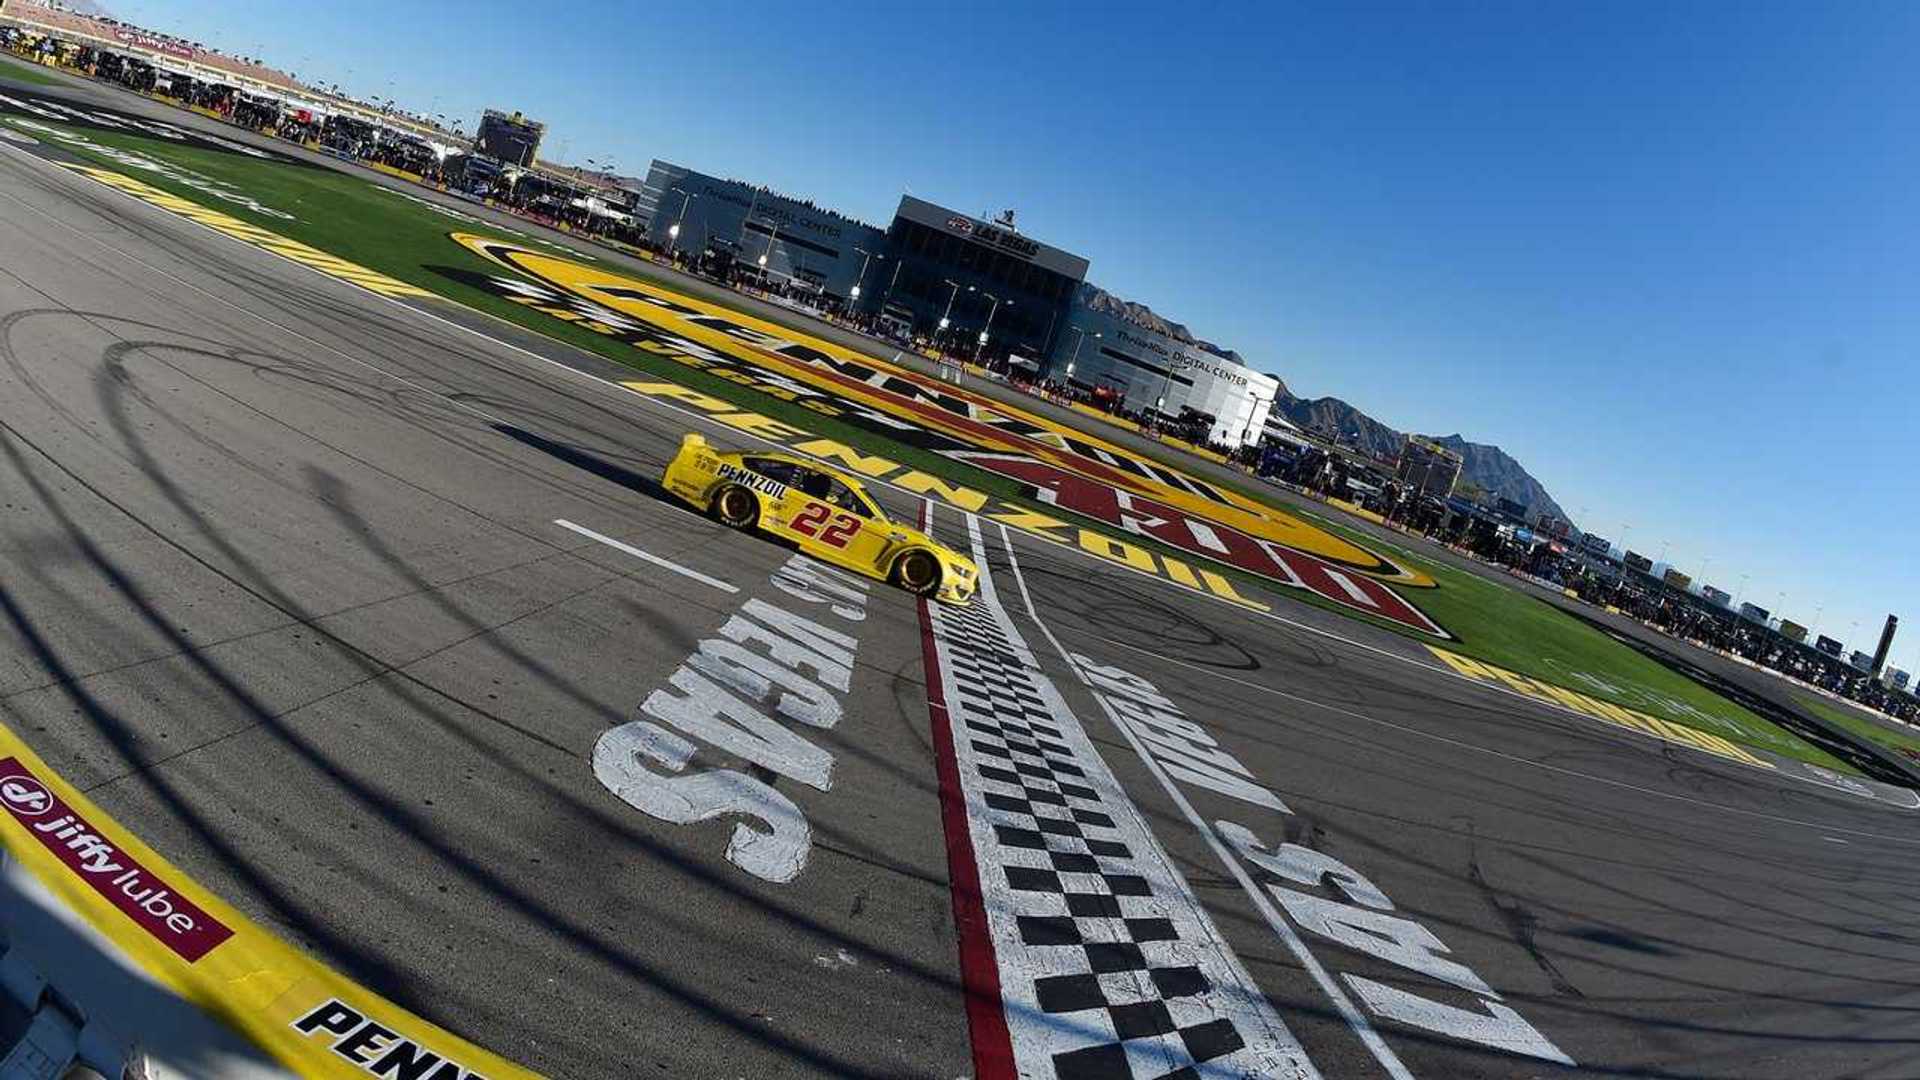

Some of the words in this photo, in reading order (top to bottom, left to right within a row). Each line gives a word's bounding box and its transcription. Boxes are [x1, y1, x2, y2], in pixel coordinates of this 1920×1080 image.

[573, 283, 1262, 519] PENNZOIL
[632, 340, 845, 417] VEGAS
[1172, 350, 1211, 374] DIGITAL
[1212, 367, 1248, 387] CENTER
[620, 382, 1271, 611] PENNZOIL
[717, 463, 786, 501] PENNZOIL
[788, 502, 864, 549] 22
[932, 448, 1452, 642] 400
[589, 597, 859, 884] VEGAS
[1070, 652, 1295, 815] VEGAS
[33, 815, 124, 873] jiffy
[111, 868, 194, 934] lube
[1213, 819, 1579, 1067] LAS
